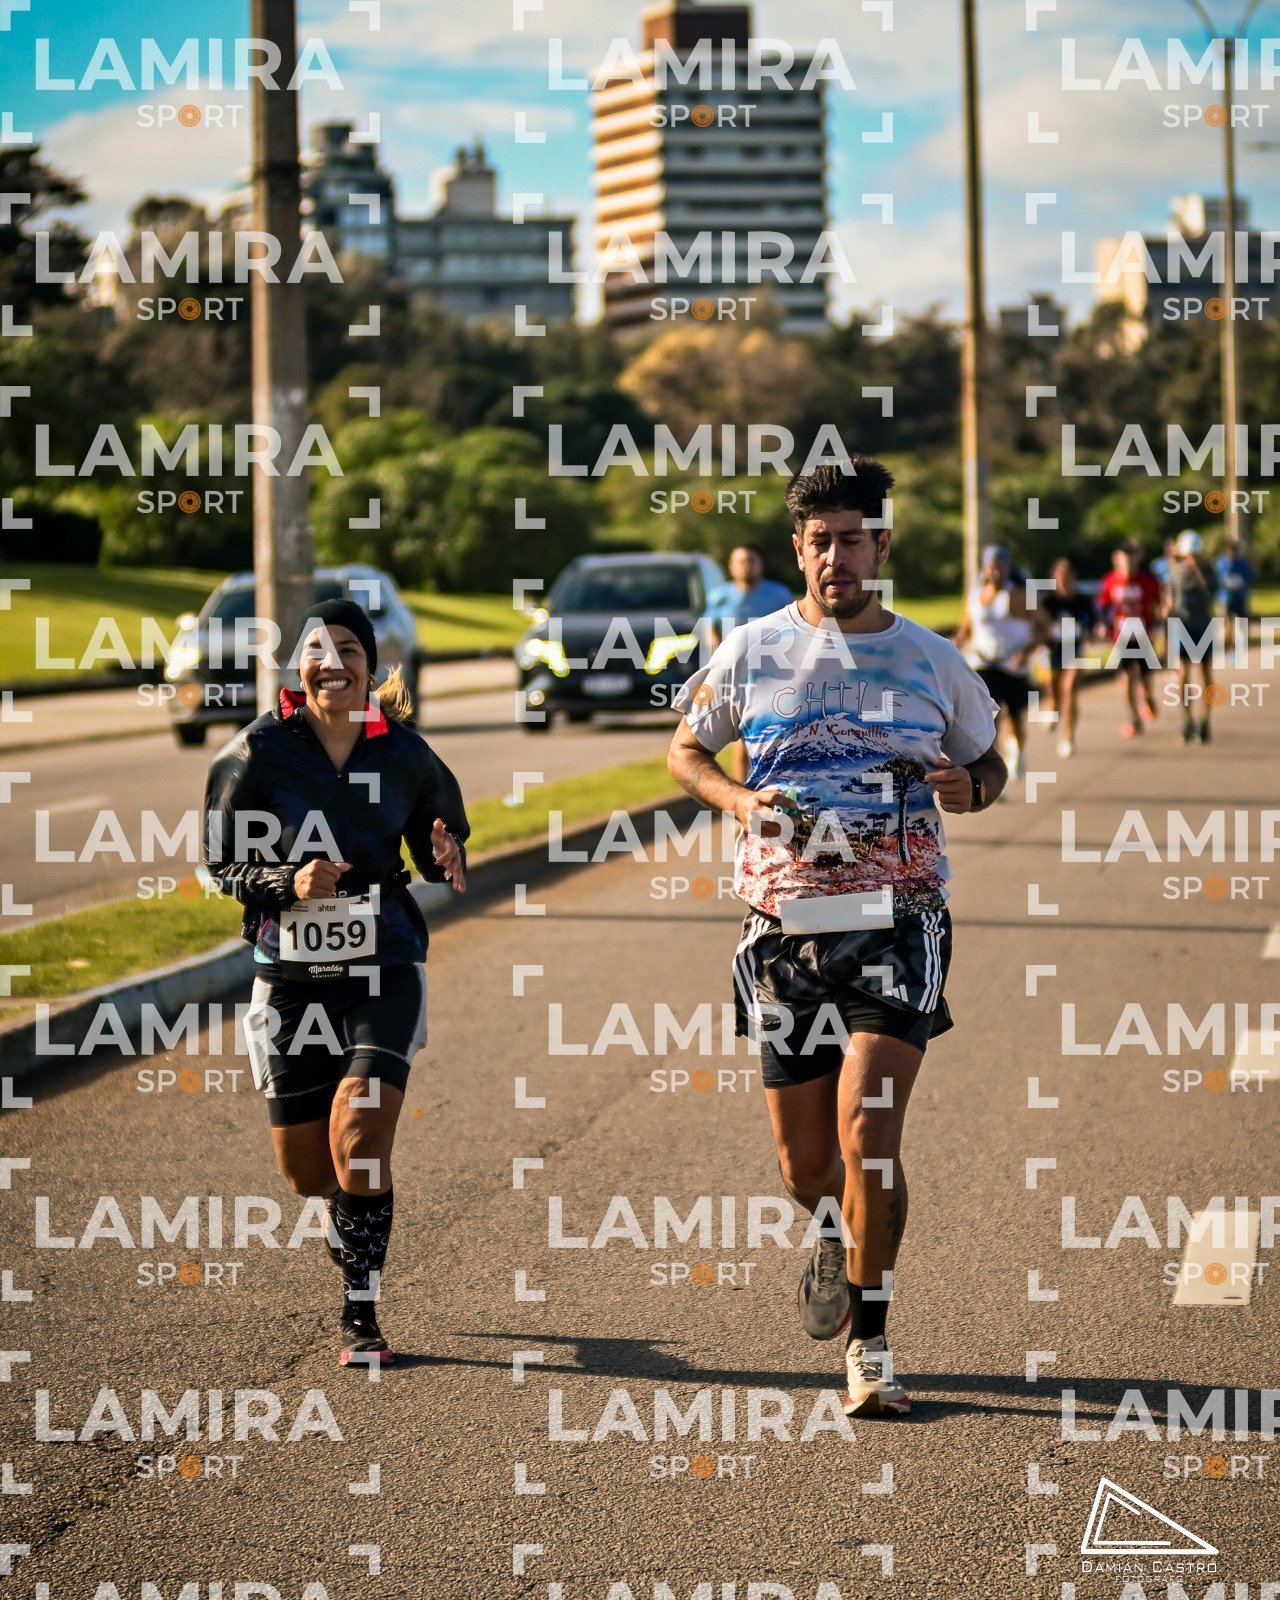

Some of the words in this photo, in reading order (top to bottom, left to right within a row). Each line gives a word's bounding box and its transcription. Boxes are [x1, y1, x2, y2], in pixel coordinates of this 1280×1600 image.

[772, 680, 908, 723] CHILE
[317, 904, 336, 913] antel
[287, 920, 366, 952] 1059
